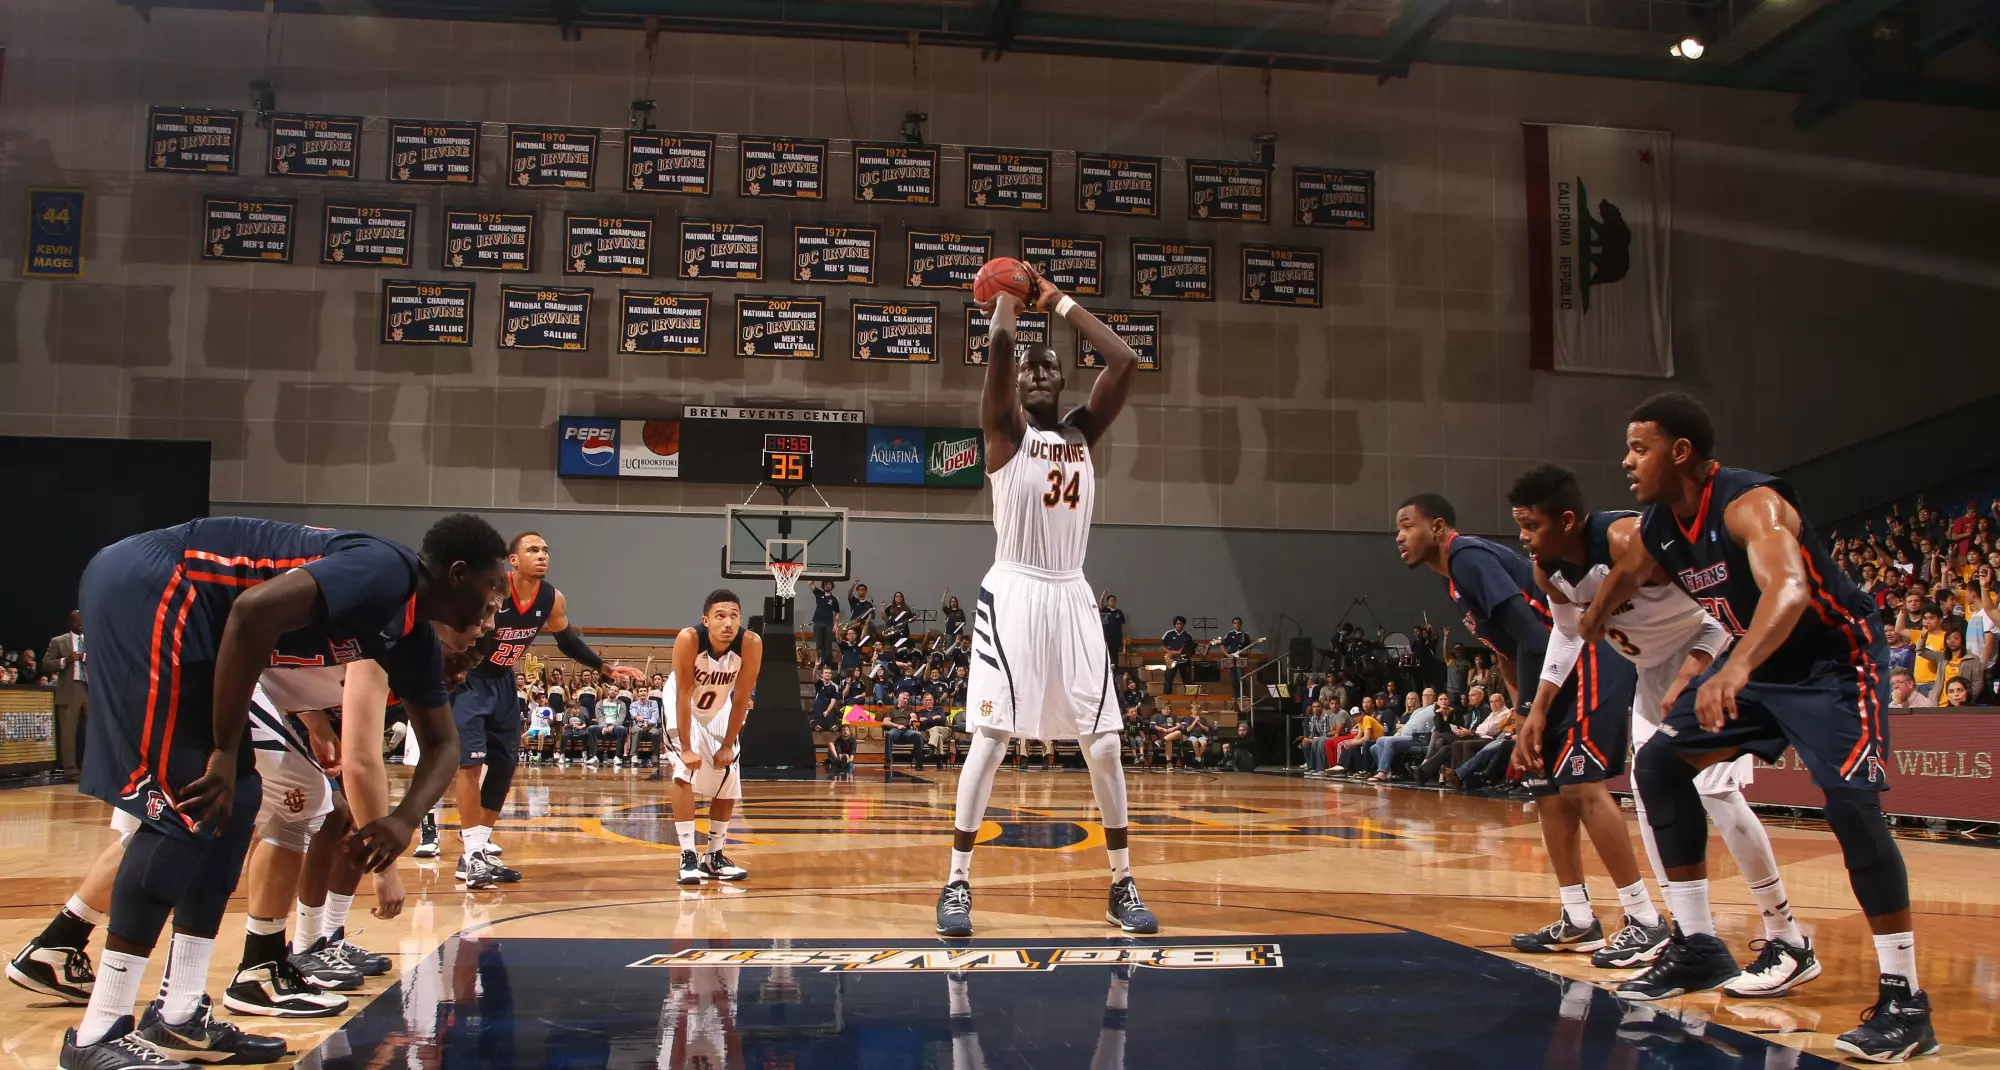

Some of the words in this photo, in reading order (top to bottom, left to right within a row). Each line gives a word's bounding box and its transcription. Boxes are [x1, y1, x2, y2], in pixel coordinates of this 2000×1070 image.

[304, 121, 327, 130] 1970
[276, 128, 307, 137] NATIONAL
[314, 130, 352, 140] CHAMPIONS
[423, 127, 446, 137] 1970
[396, 136, 427, 144] NATIONAL
[433, 137, 470, 145] CHAMPIONS
[542, 133, 566, 143] 1970
[660, 138, 681, 148] 1971
[274, 143, 296, 160] UC
[302, 139, 351, 154] IRVINE
[772, 143, 795, 153] 1971
[886, 148, 908, 158] 1972
[395, 150, 417, 167] UC
[421, 145, 470, 161] IRVINE
[746, 151, 776, 160] NATIONAL
[782, 153, 819, 162] CHAMPIONS
[997, 155, 1019, 164] 1972
[305, 157, 327, 166] WATER
[332, 158, 350, 167] POLO
[860, 157, 890, 165] NATIONAL
[894, 159, 931, 167] CHAMPIONS
[1108, 160, 1129, 170] 1973
[423, 164, 444, 172] MEN'S
[447, 164, 469, 173] TENNIS
[745, 164, 766, 182] UC
[770, 161, 818, 176] IRVINE
[860, 170, 880, 187] UC
[882, 166, 930, 182] IRVINE
[772, 178, 793, 187] MEN'S
[796, 180, 818, 189] TENNIS
[897, 185, 930, 194] SAILING
[1115, 195, 1151, 205] BASEBALL
[237, 202, 262, 212] 1975
[43, 208, 70, 224] 44
[210, 211, 241, 219] NATIONAL
[249, 213, 287, 222] CHAMPIONS
[357, 208, 381, 217] 1975
[1558, 182, 1571, 247] CALIFORNIA
[331, 216, 361, 225] NATIONAL
[368, 218, 406, 227] CHAMPIONS
[478, 214, 502, 223] 1975
[599, 219, 622, 228] 1976
[210, 224, 231, 243] UC
[236, 222, 286, 236] IRVINE
[451, 222, 482, 230] NATIONAL
[488, 224, 526, 233] CHAMPIONS
[572, 227, 603, 235] NATIONAL
[609, 229, 646, 237] CHAMPIONS
[711, 223, 735, 233] 1977
[824, 228, 847, 237] 1977
[330, 231, 351, 247] UC
[355, 227, 405, 241] IRVINE
[685, 232, 715, 241] NATIONAL
[722, 234, 758, 242] CHAMPIONS
[799, 237, 828, 245] NATIONAL
[834, 238, 870, 247] CHAMPIONS
[940, 233, 961, 243] 1979
[242, 241, 264, 249] MEN'S
[267, 241, 284, 250] GOLF
[450, 236, 472, 253] UC
[476, 233, 525, 248] IRVINE
[571, 242, 592, 258] UC
[597, 238, 645, 251] IRVINE
[914, 242, 945, 251] NATIONAL
[948, 244, 985, 253] CHAMPIONS
[1051, 239, 1073, 249] 1982
[36, 244, 72, 255] KEVIN
[684, 246, 705, 263] UC
[710, 242, 758, 257] IRVINE
[1026, 247, 1056, 255] NATIONAL
[1061, 249, 1097, 258] CHAMPIONS
[1162, 245, 1185, 254] 1988
[478, 251, 499, 259] MEN'S
[502, 252, 524, 260] TENNIS
[799, 250, 819, 267] UC
[822, 246, 869, 261] IRVINE
[1137, 253, 1166, 262] NATIONAL
[1171, 255, 1207, 263] CHAMPIONS
[33, 257, 74, 268] MAGEE
[914, 257, 935, 273] UC
[936, 254, 983, 268] IRVINE
[824, 264, 845, 272] MEN'S
[848, 265, 869, 274] TENNIS
[1137, 267, 1157, 283] UC
[1160, 263, 1207, 278] IRVINE
[1053, 275, 1074, 283] WATER
[1079, 276, 1096, 284] POLO
[1175, 280, 1207, 289] SAILING
[1559, 256, 1572, 310] REPUBLIC
[417, 287, 442, 296] 1990
[536, 292, 558, 301] 1992
[427, 297, 464, 306] CHAMPIONS
[509, 301, 541, 310] NATIONAL
[544, 302, 583, 312] CHAMPIONS
[654, 297, 678, 306] 2005
[768, 301, 792, 310] 2007
[629, 306, 660, 315] NATIONAL
[663, 308, 702, 316] CHAMPIONS
[743, 309, 774, 318] NATIONAL
[778, 311, 817, 319] CHAMPIONS
[882, 306, 908, 315] 2009
[391, 310, 412, 327] UC
[414, 306, 464, 321] IRVINE
[857, 313, 890, 322] NATIONAL
[893, 315, 933, 324] CHAMPIONS
[1107, 314, 1128, 323] 2013
[508, 315, 529, 332] UC
[531, 312, 580, 326] IRVINE
[428, 324, 464, 333] SAILING
[627, 321, 649, 338] UC
[651, 317, 701, 333] IRVINE
[742, 324, 764, 341] UC
[766, 320, 816, 335] IRVINE
[543, 330, 578, 340] SAILING
[663, 335, 699, 344] SAILING
[781, 335, 804, 343] MEN'S
[857, 328, 879, 346] UC
[882, 323, 932, 339] IRVINE
[773, 342, 815, 351] VOLLEYBALL
[897, 339, 920, 347] MEN'S
[887, 346, 931, 355] VOLLEYBALL
[690, 409, 728, 417] BREN
[739, 411, 795, 420] EVENTS
[803, 412, 858, 421] CENTER
[564, 427, 616, 441] PEPSI
[776, 437, 808, 451] 4:55
[869, 444, 920, 466] AQUAFINA
[931, 438, 977, 471] MOUNTAIN
[625, 459, 641, 470] UCI
[641, 459, 678, 467] BOOKSTORE
[771, 454, 803, 480] 35
[1043, 469, 1080, 510] 34
[1606, 628, 1641, 656] 3
[490, 643, 525, 666] 23
[696, 691, 717, 711] 0
[1894, 750, 1992, 780] WELLS
